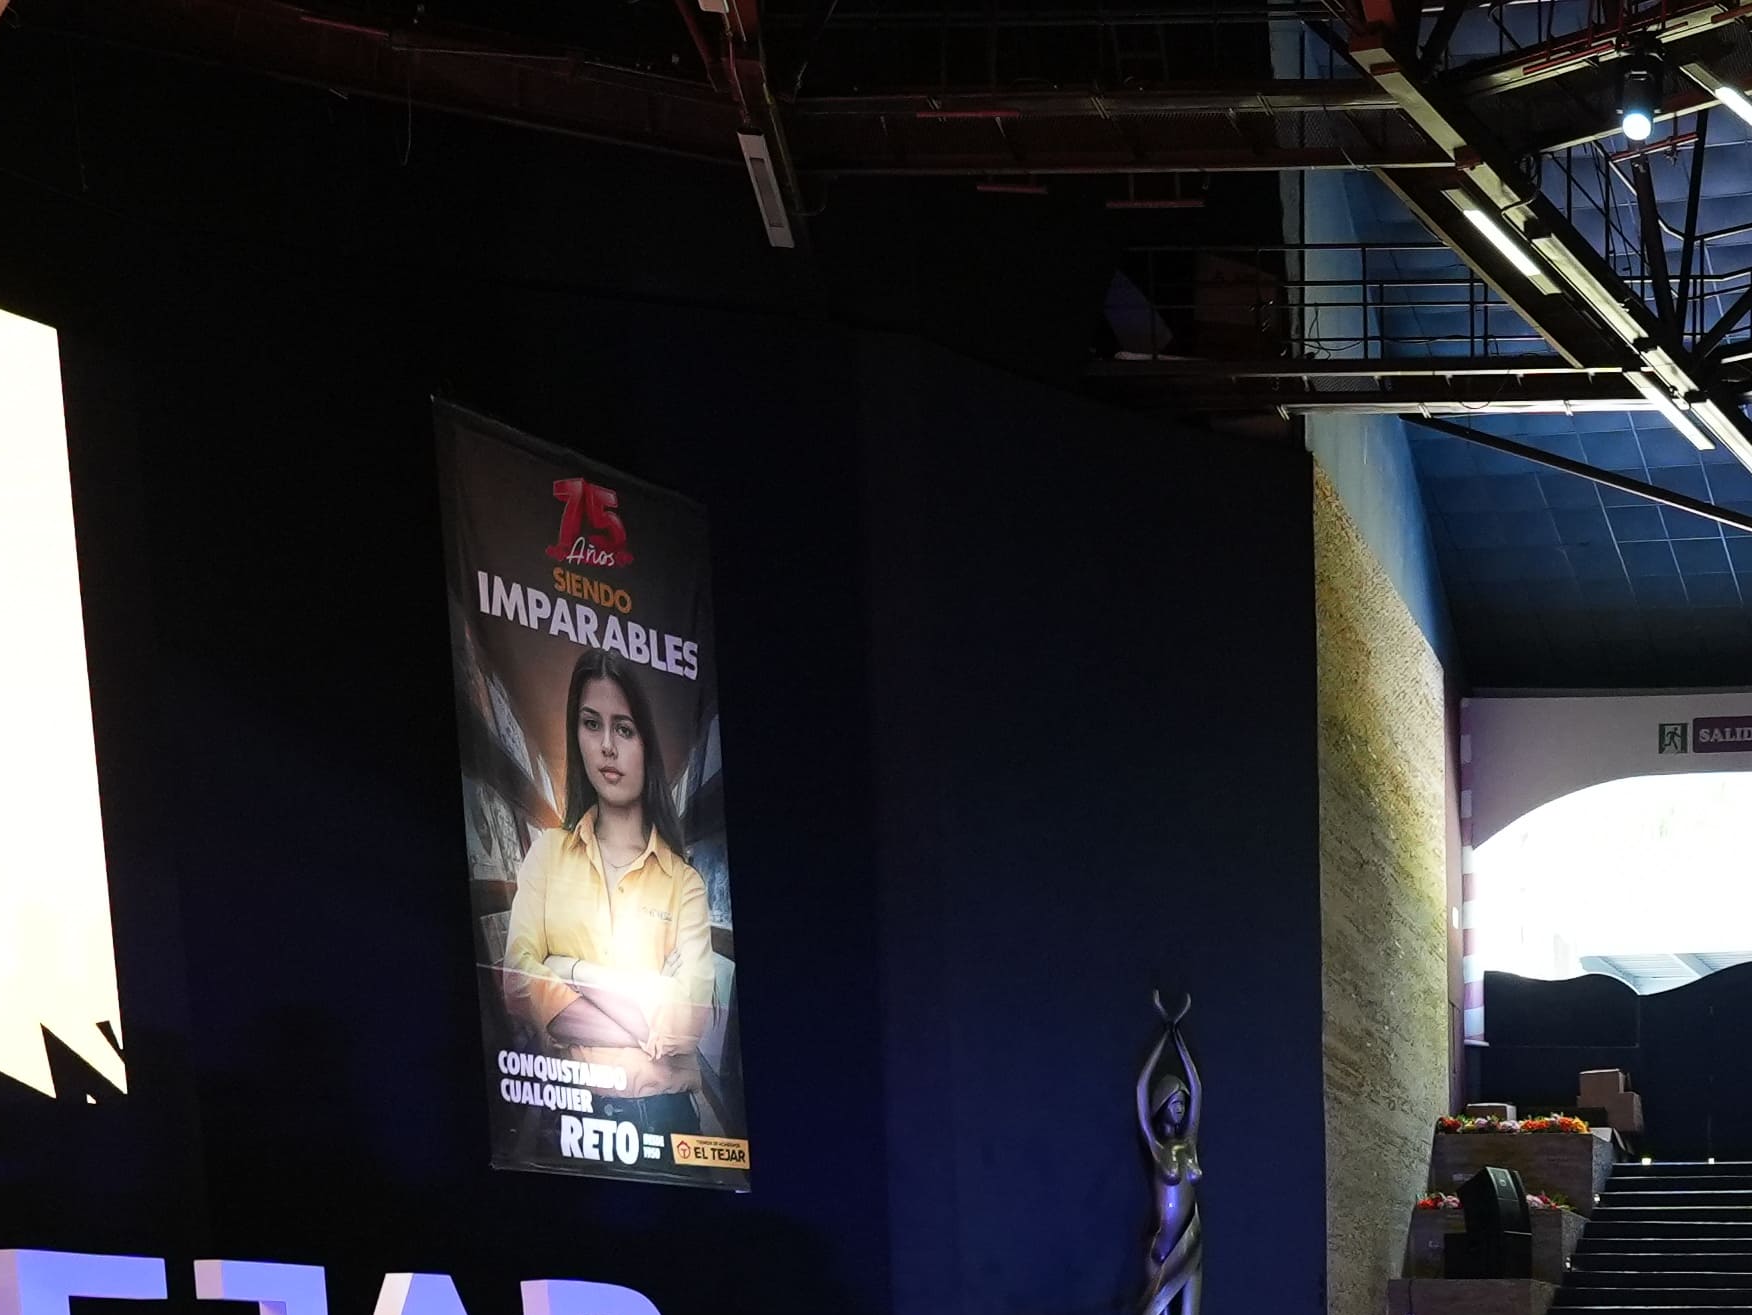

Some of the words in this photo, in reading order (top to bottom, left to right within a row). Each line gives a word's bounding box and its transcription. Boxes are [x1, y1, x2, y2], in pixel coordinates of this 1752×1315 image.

[552, 477, 629, 550] 75
[566, 536, 616, 567] Años
[552, 566, 633, 615] SIENDO
[477, 570, 699, 681] IMPARABLES
[500, 1078, 594, 1113] CUALQUIER
[560, 1115, 640, 1165] RETO
[694, 1147, 708, 1160] EL
[710, 1147, 746, 1164] TEJAR
